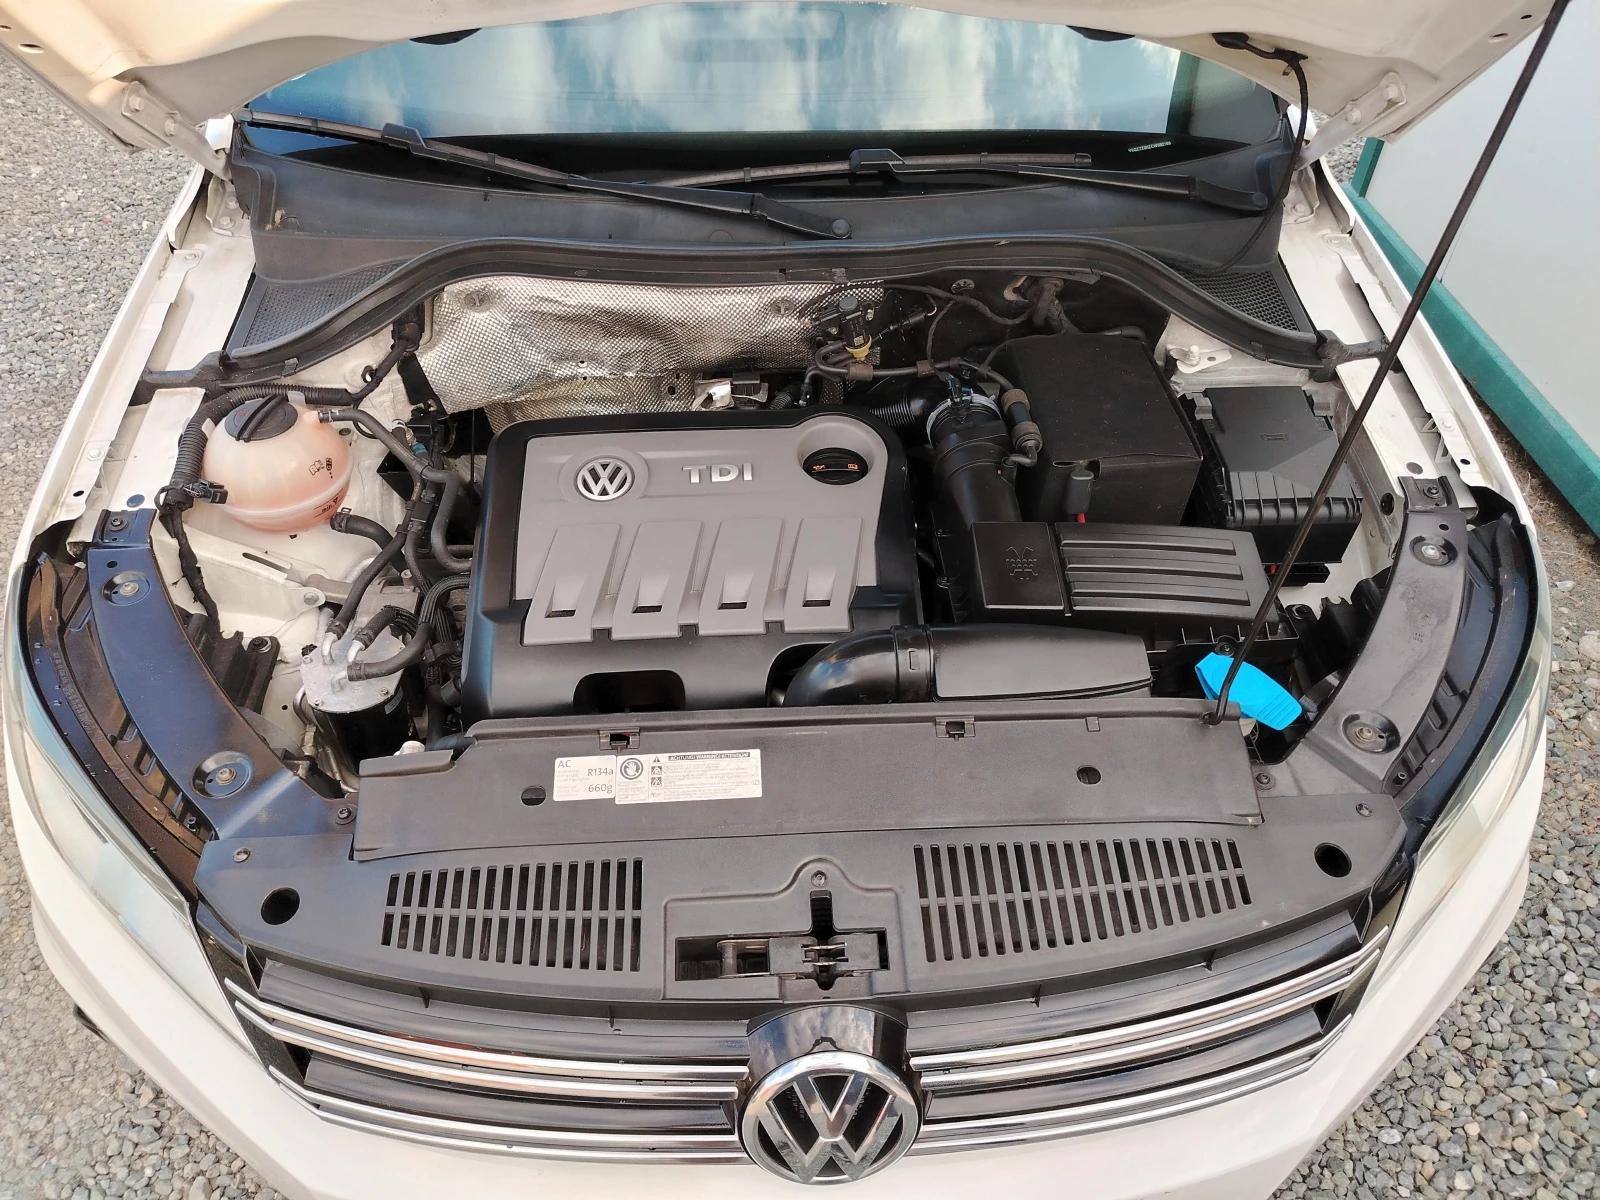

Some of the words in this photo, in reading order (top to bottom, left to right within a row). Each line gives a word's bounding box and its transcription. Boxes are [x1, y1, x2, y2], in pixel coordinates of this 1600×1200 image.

[682, 462, 754, 483] TDI
[578, 459, 632, 500] VW
[321, 504, 333, 513] min
[557, 759, 572, 768] AC
[587, 767, 614, 777] R134a
[588, 783, 613, 794] 660g
[752, 1066, 908, 1185] VW
